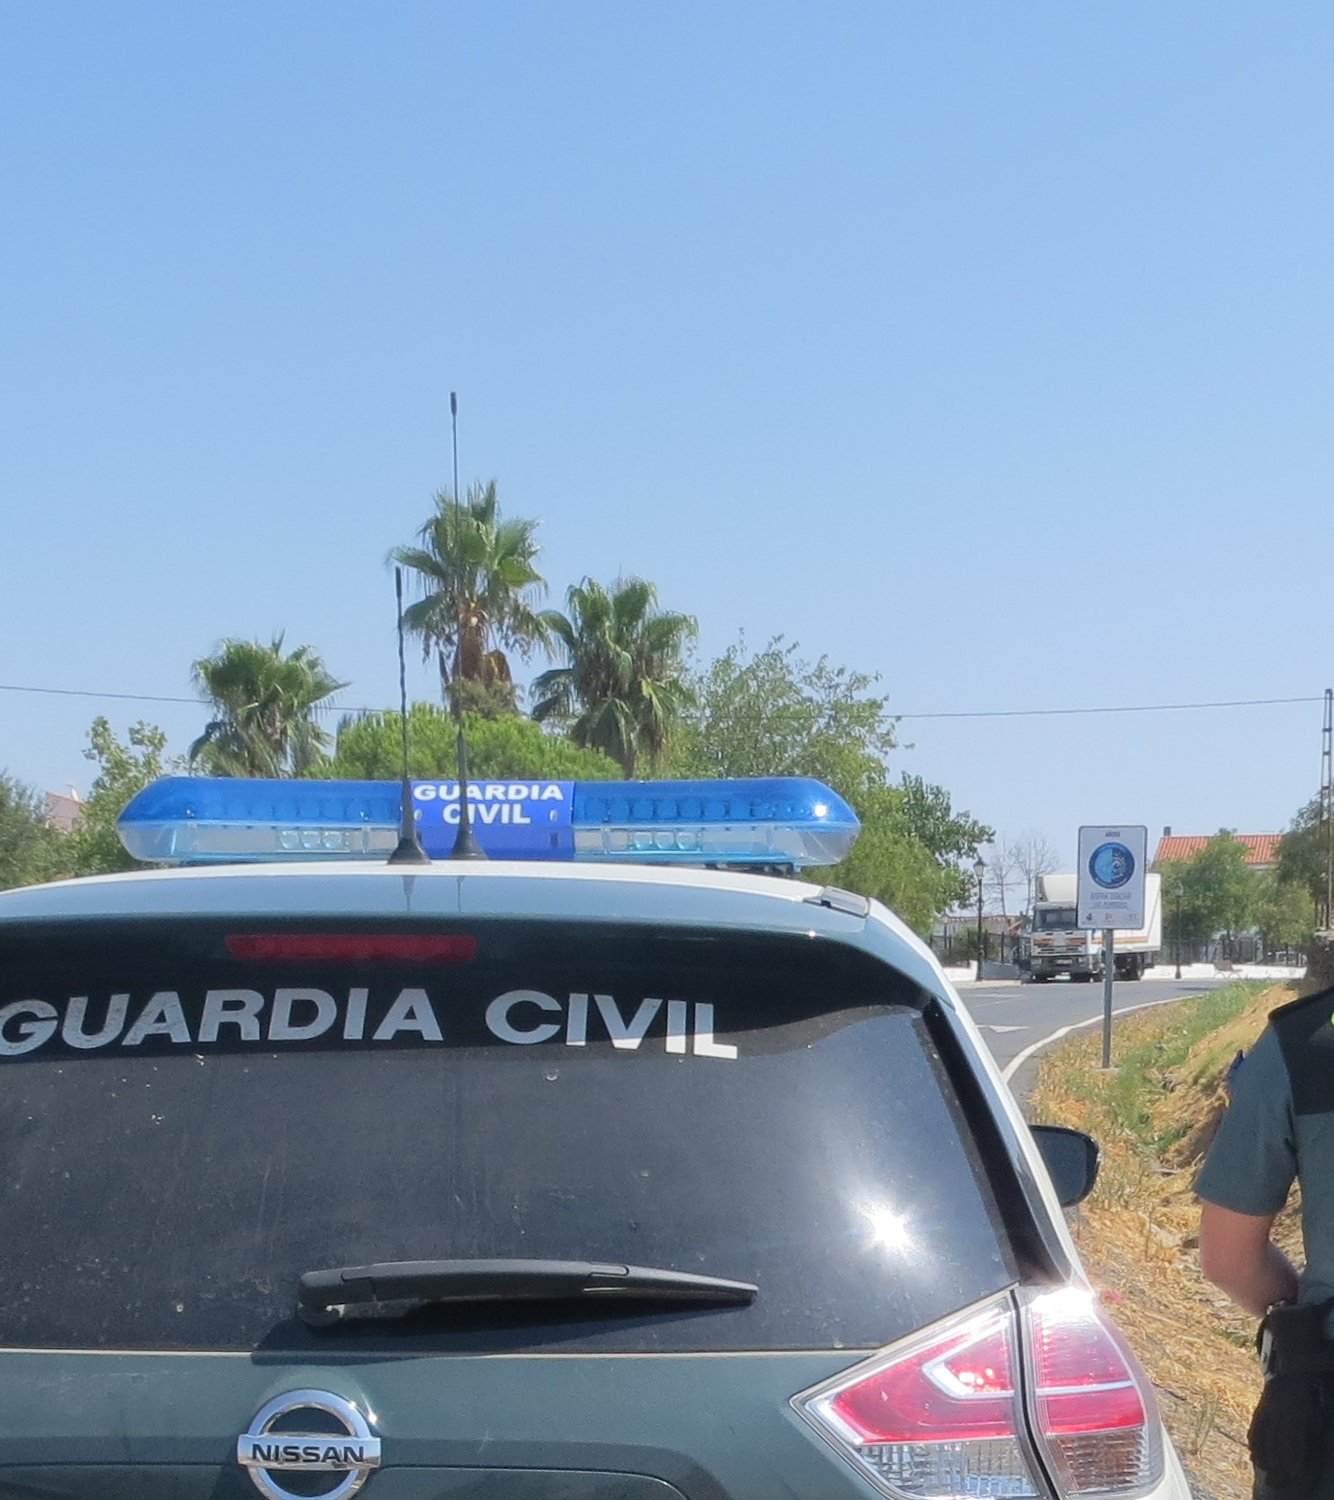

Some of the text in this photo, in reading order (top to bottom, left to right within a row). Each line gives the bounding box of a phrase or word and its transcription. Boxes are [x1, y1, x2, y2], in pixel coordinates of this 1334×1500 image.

[413, 784, 564, 801] GUARDIA
[442, 803, 531, 825] CIVIL
[484, 989, 739, 1061] CIVIL
[250, 1443, 366, 1466] NISSAN
